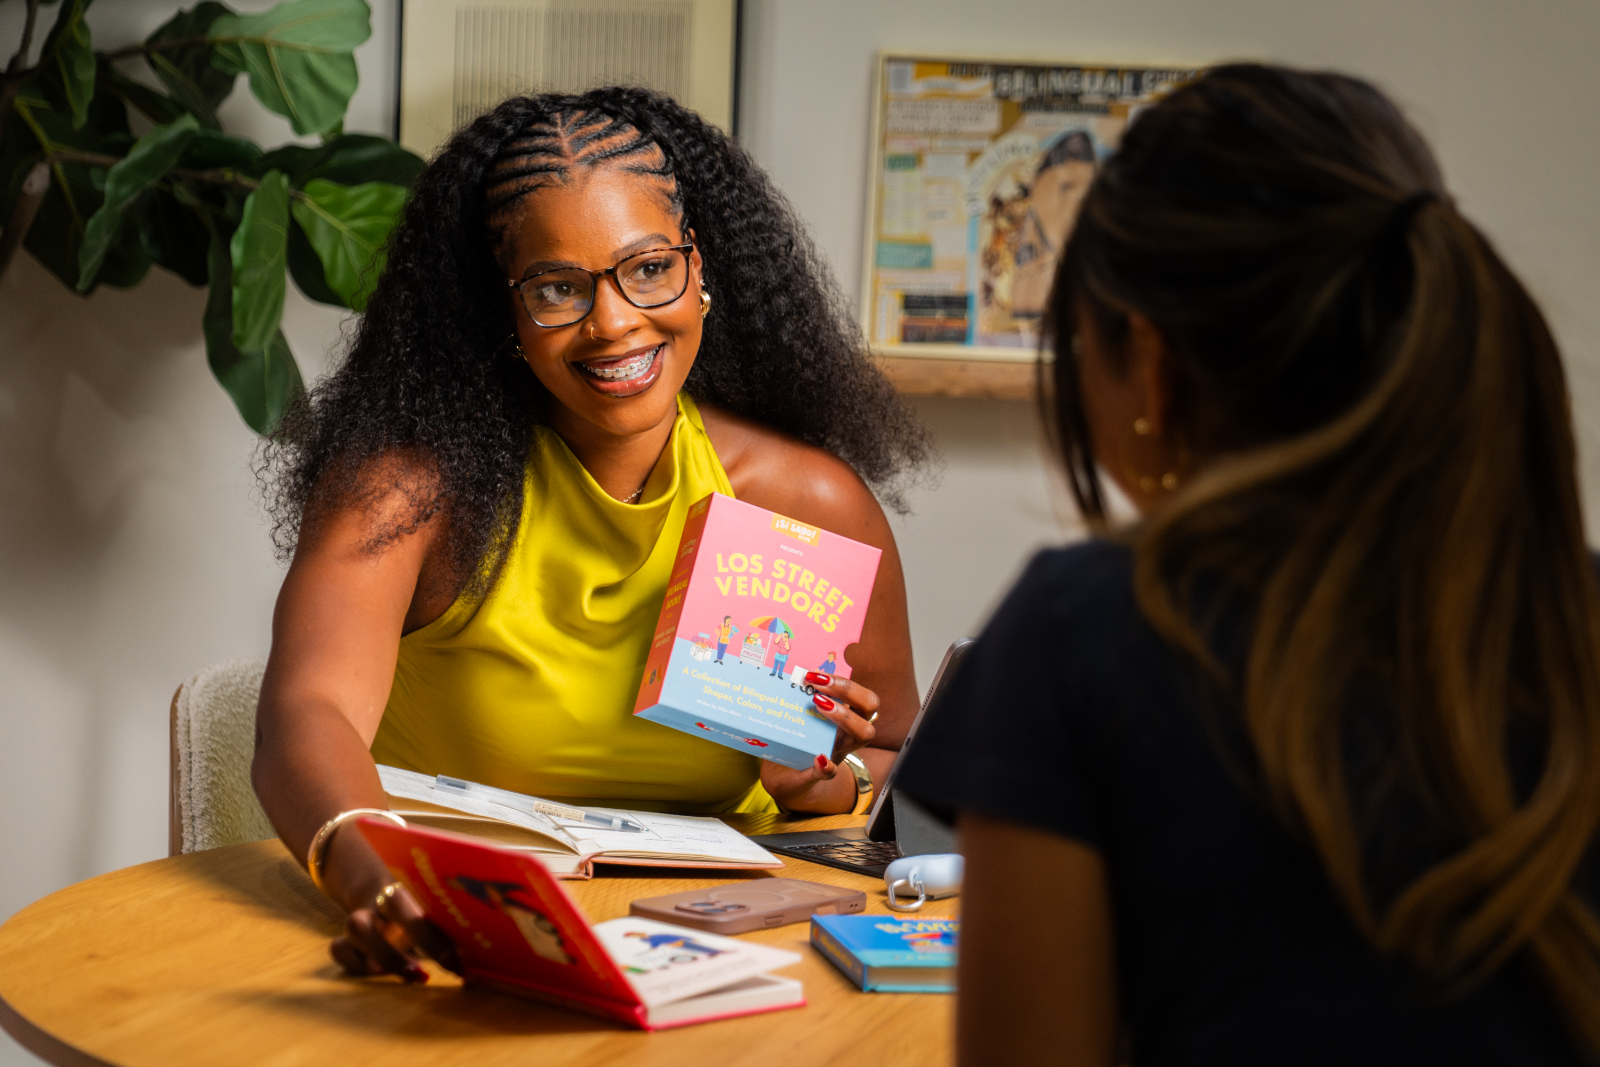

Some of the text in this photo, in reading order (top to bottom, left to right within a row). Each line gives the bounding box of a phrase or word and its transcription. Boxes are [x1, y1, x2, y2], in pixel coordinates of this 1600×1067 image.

[790, 523, 816, 539] SABO!
[714, 576, 840, 633] VENDORS
[716, 552, 854, 614] LOS STREET
[682, 667, 689, 675] A
[691, 669, 731, 689] Collection
[732, 684, 742, 692] of
[742, 686, 778, 705] Bilingual
[779, 698, 804, 713] Books
[703, 685, 805, 726] Shapes, Colors, and Fruits
